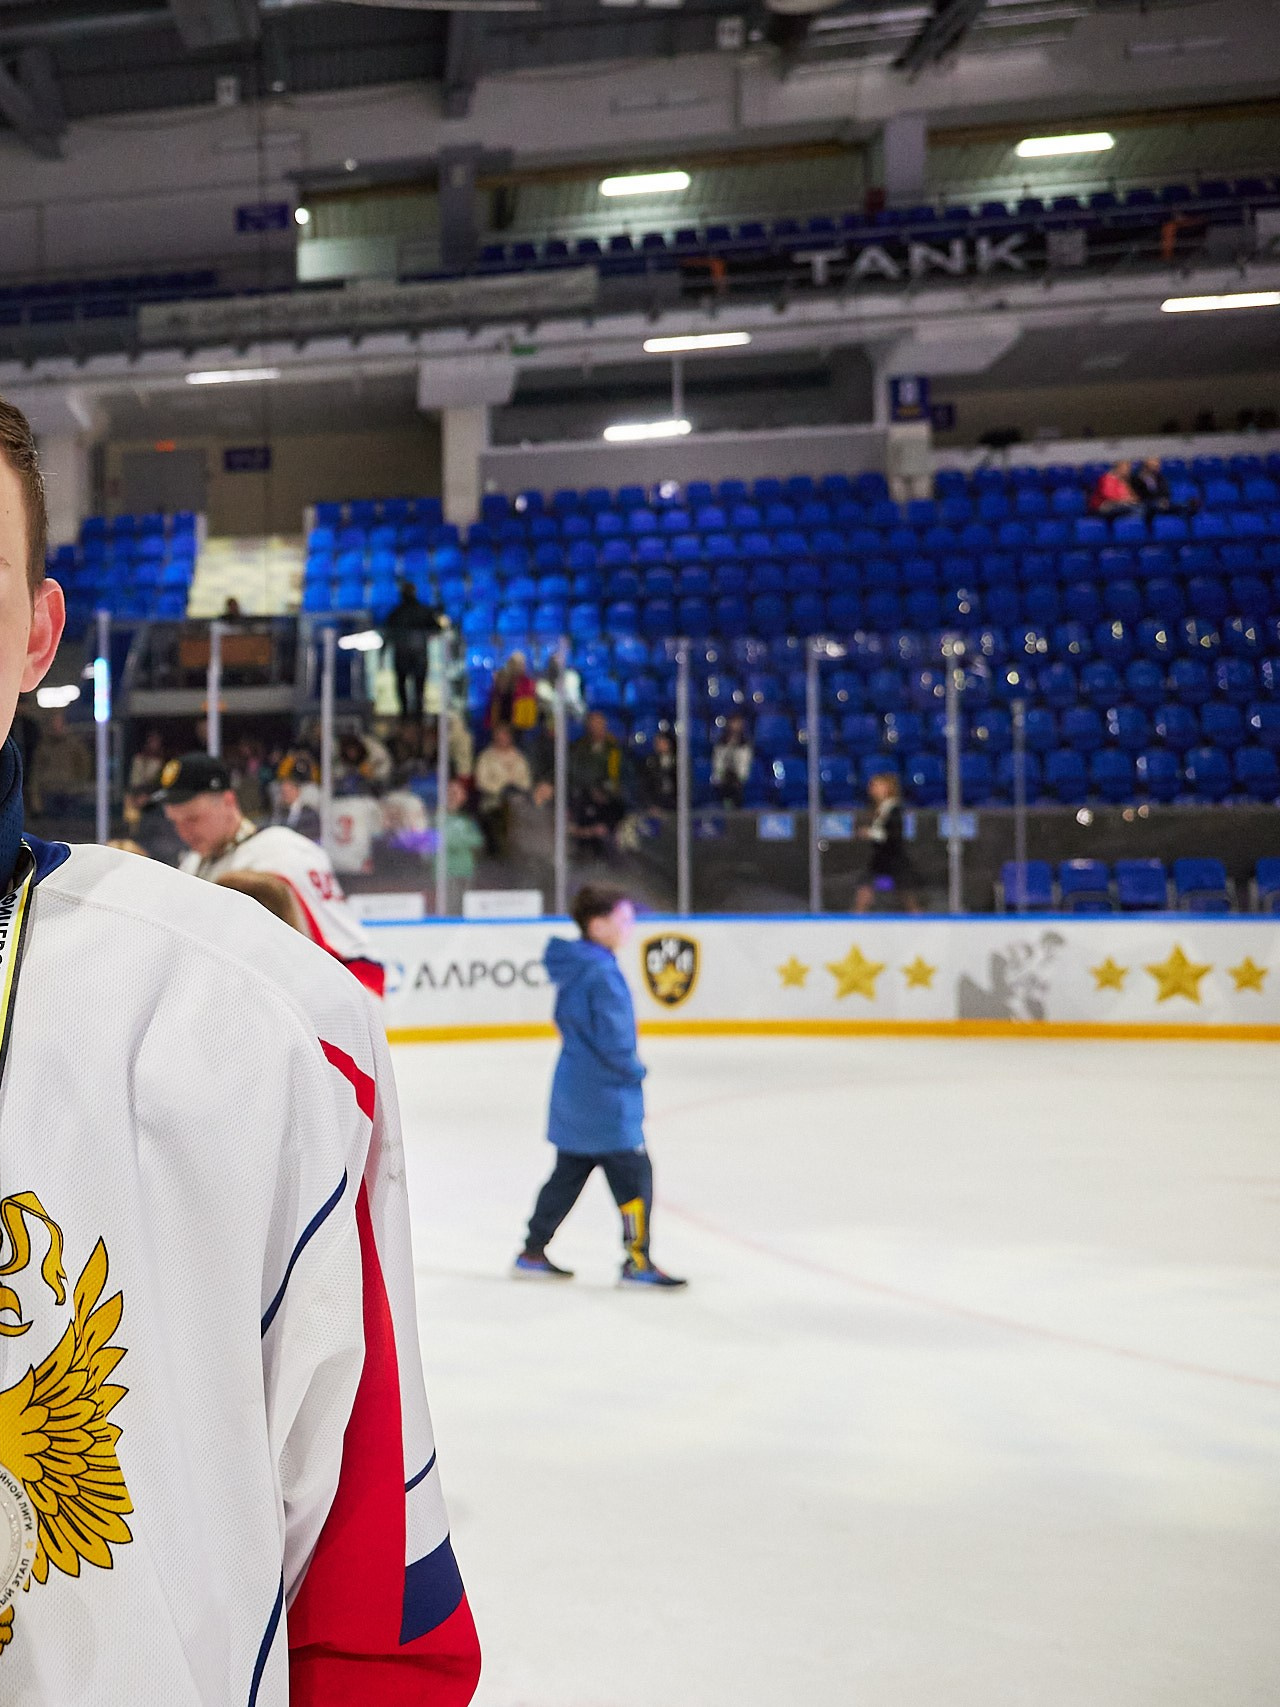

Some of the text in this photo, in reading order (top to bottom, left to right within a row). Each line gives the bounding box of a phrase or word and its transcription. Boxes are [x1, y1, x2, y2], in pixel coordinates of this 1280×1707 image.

[792, 233, 1028, 287] TANK
[414, 960, 548, 988] АЛРОС
[18, 1501, 34, 1532] ЛИГИ
[14, 1558, 30, 1588] ЭТАП
